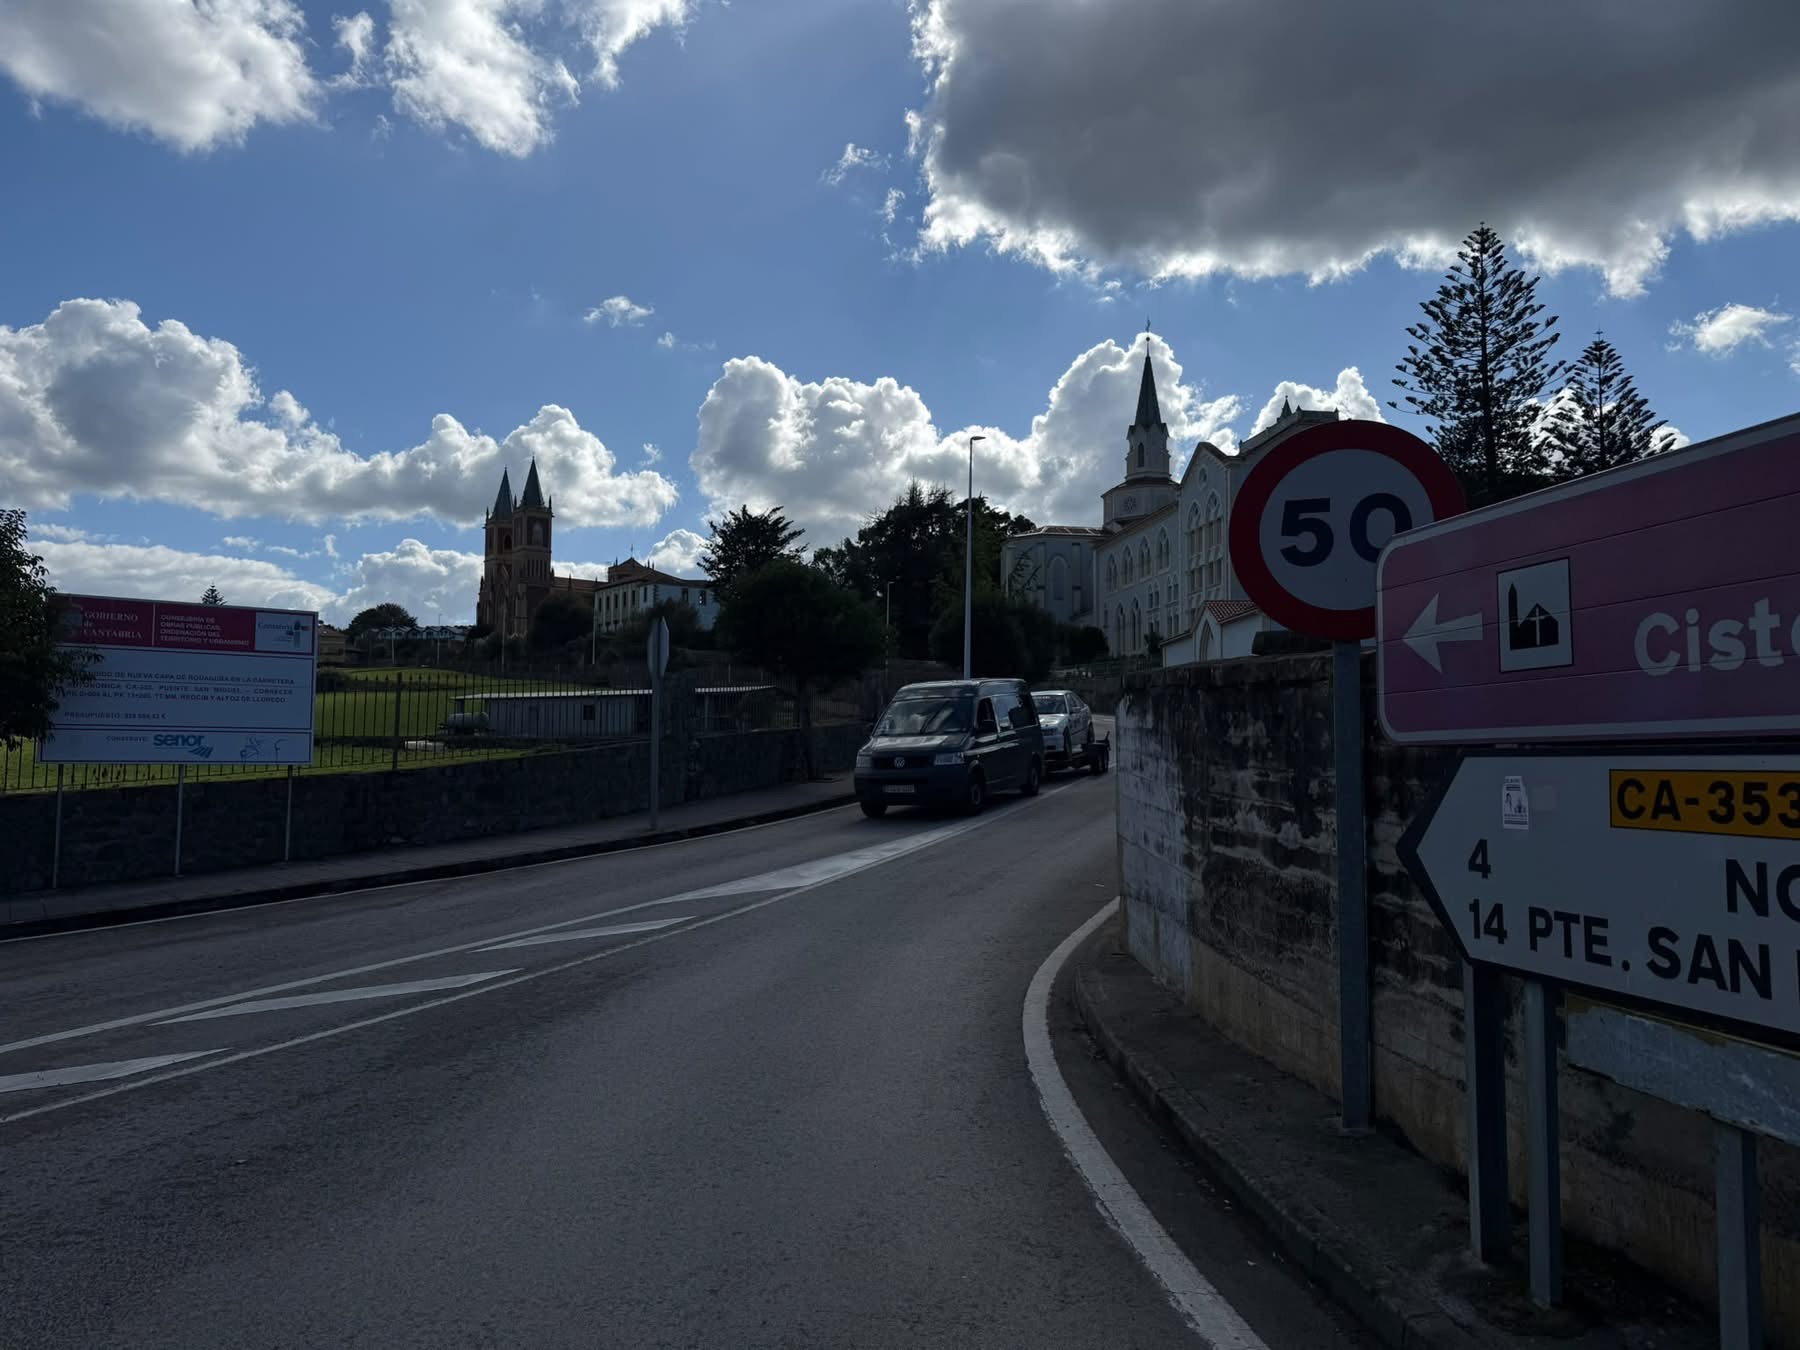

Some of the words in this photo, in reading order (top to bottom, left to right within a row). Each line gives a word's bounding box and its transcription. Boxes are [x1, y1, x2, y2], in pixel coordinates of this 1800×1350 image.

[1280, 493, 1412, 566] 50
[83, 628, 144, 639] CANTABRIA
[84, 611, 138, 622] GOBIERNO
[1633, 597, 1800, 677] Cist
[1617, 779, 1800, 827] CA-353
[1469, 839, 1491, 878] 4
[1469, 899, 1507, 944] 14
[1529, 906, 1630, 972] PTE.
[1647, 927, 1772, 1000] SAN
